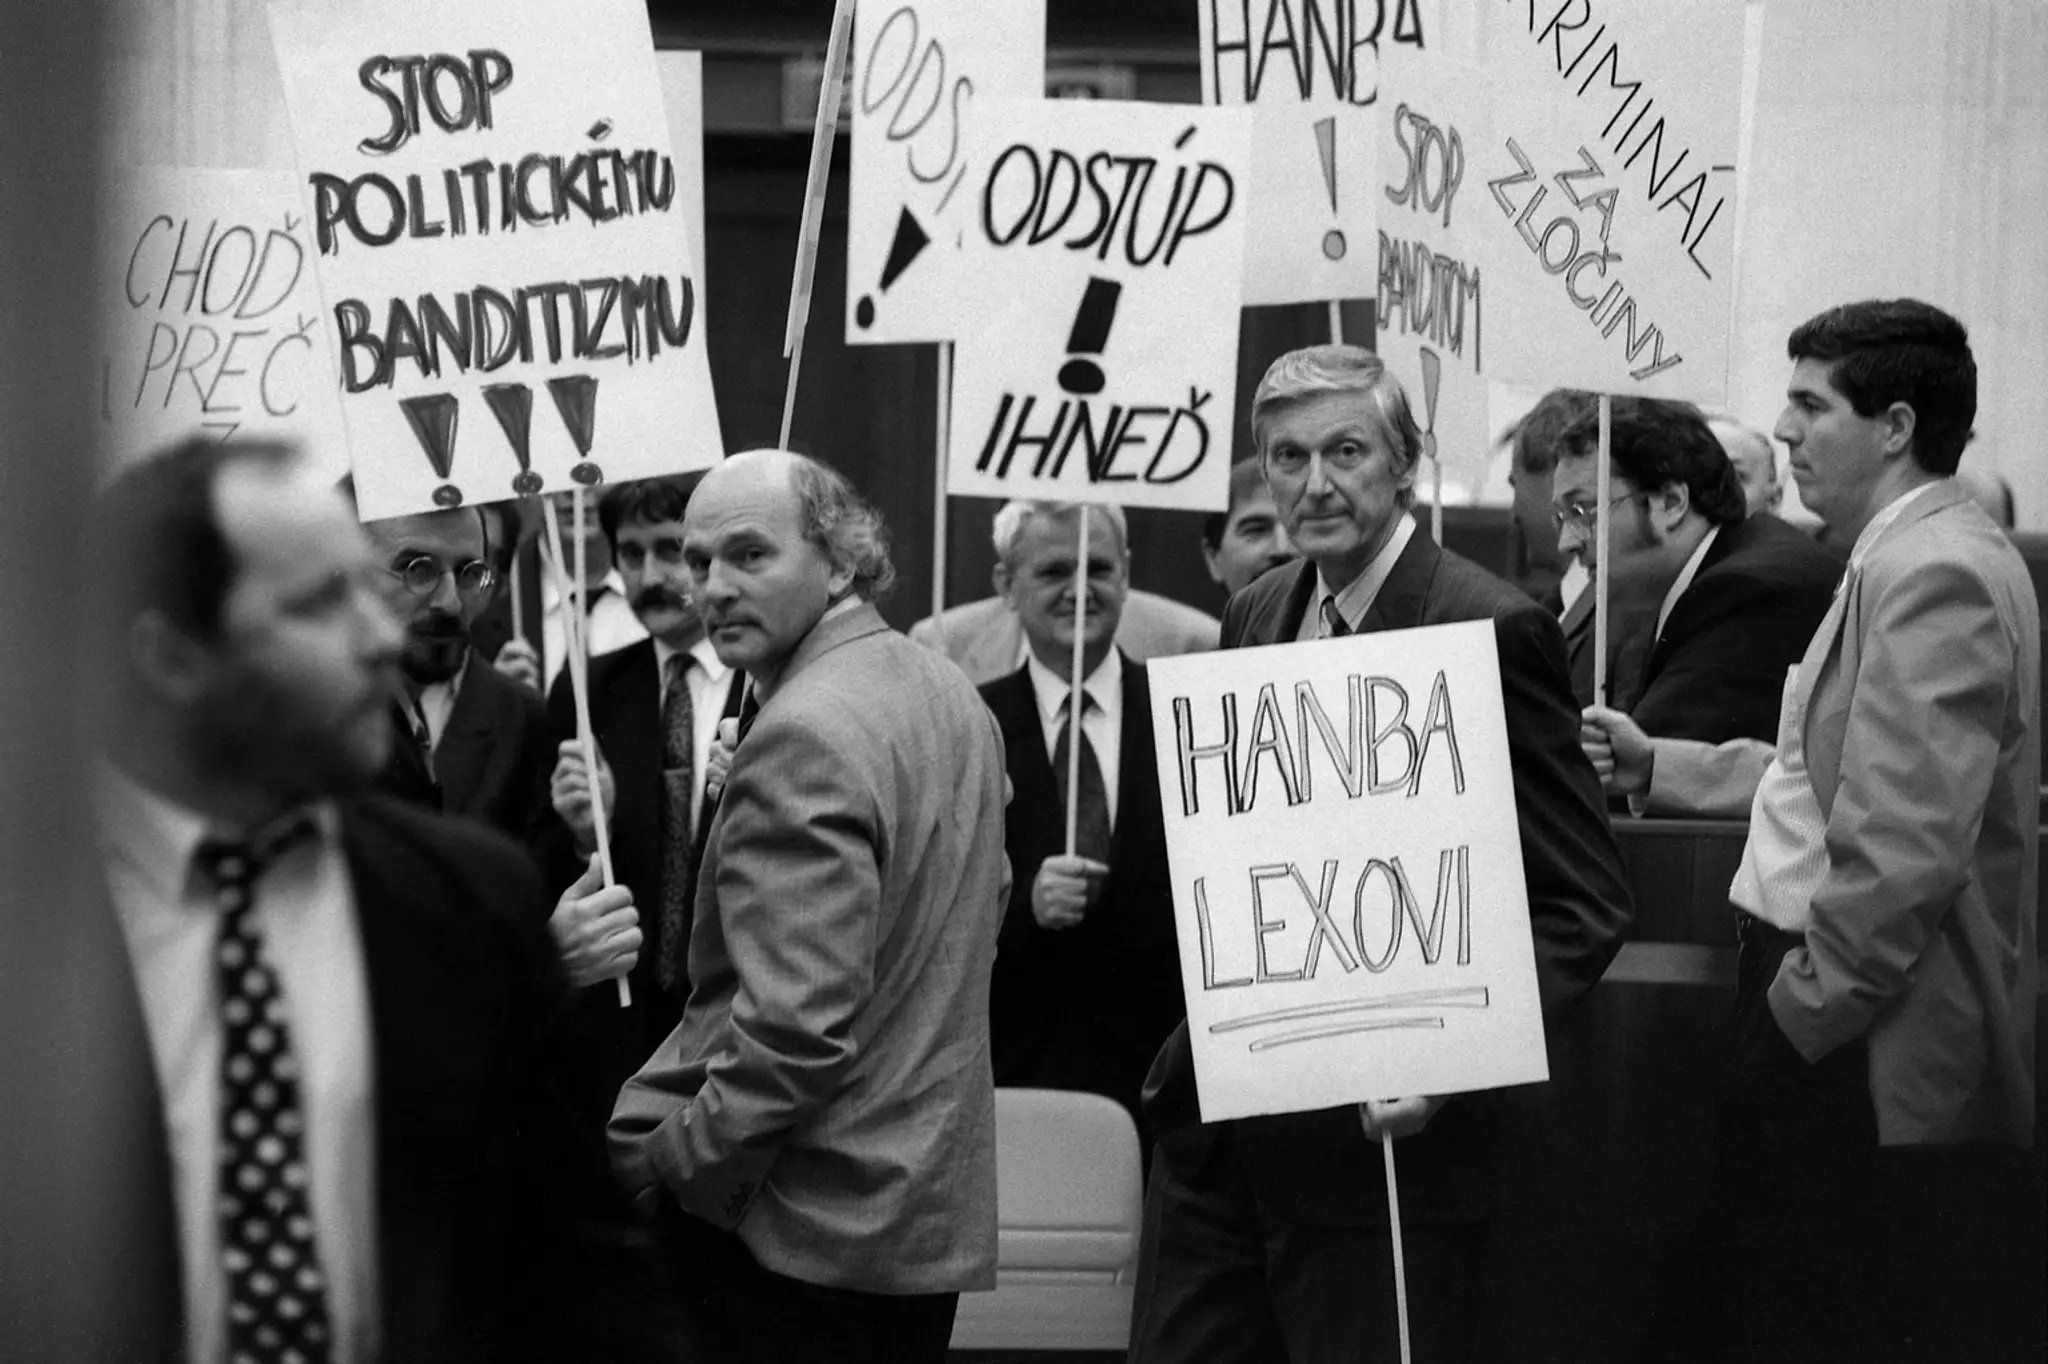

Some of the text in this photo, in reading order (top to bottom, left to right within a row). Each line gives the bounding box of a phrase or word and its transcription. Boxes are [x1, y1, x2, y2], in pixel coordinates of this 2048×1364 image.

[360, 49, 513, 154] STOP
[1526, 0, 1735, 280] RIMINÁL
[309, 118, 675, 256] POLITICKÉMU
[981, 125, 1234, 268] ODSTÚP
[1385, 102, 1465, 228] STOP
[1553, 145, 1619, 243] ZA
[125, 211, 303, 320] CHOĎ
[1487, 136, 1683, 382] ZLOČINY
[134, 313, 318, 416] PREČ
[335, 274, 695, 394] BANDITIZMU
[976, 386, 1212, 484] IHNEĎ
[1173, 670, 1465, 816] HANBA
[1194, 845, 1470, 991] LEXOVI
